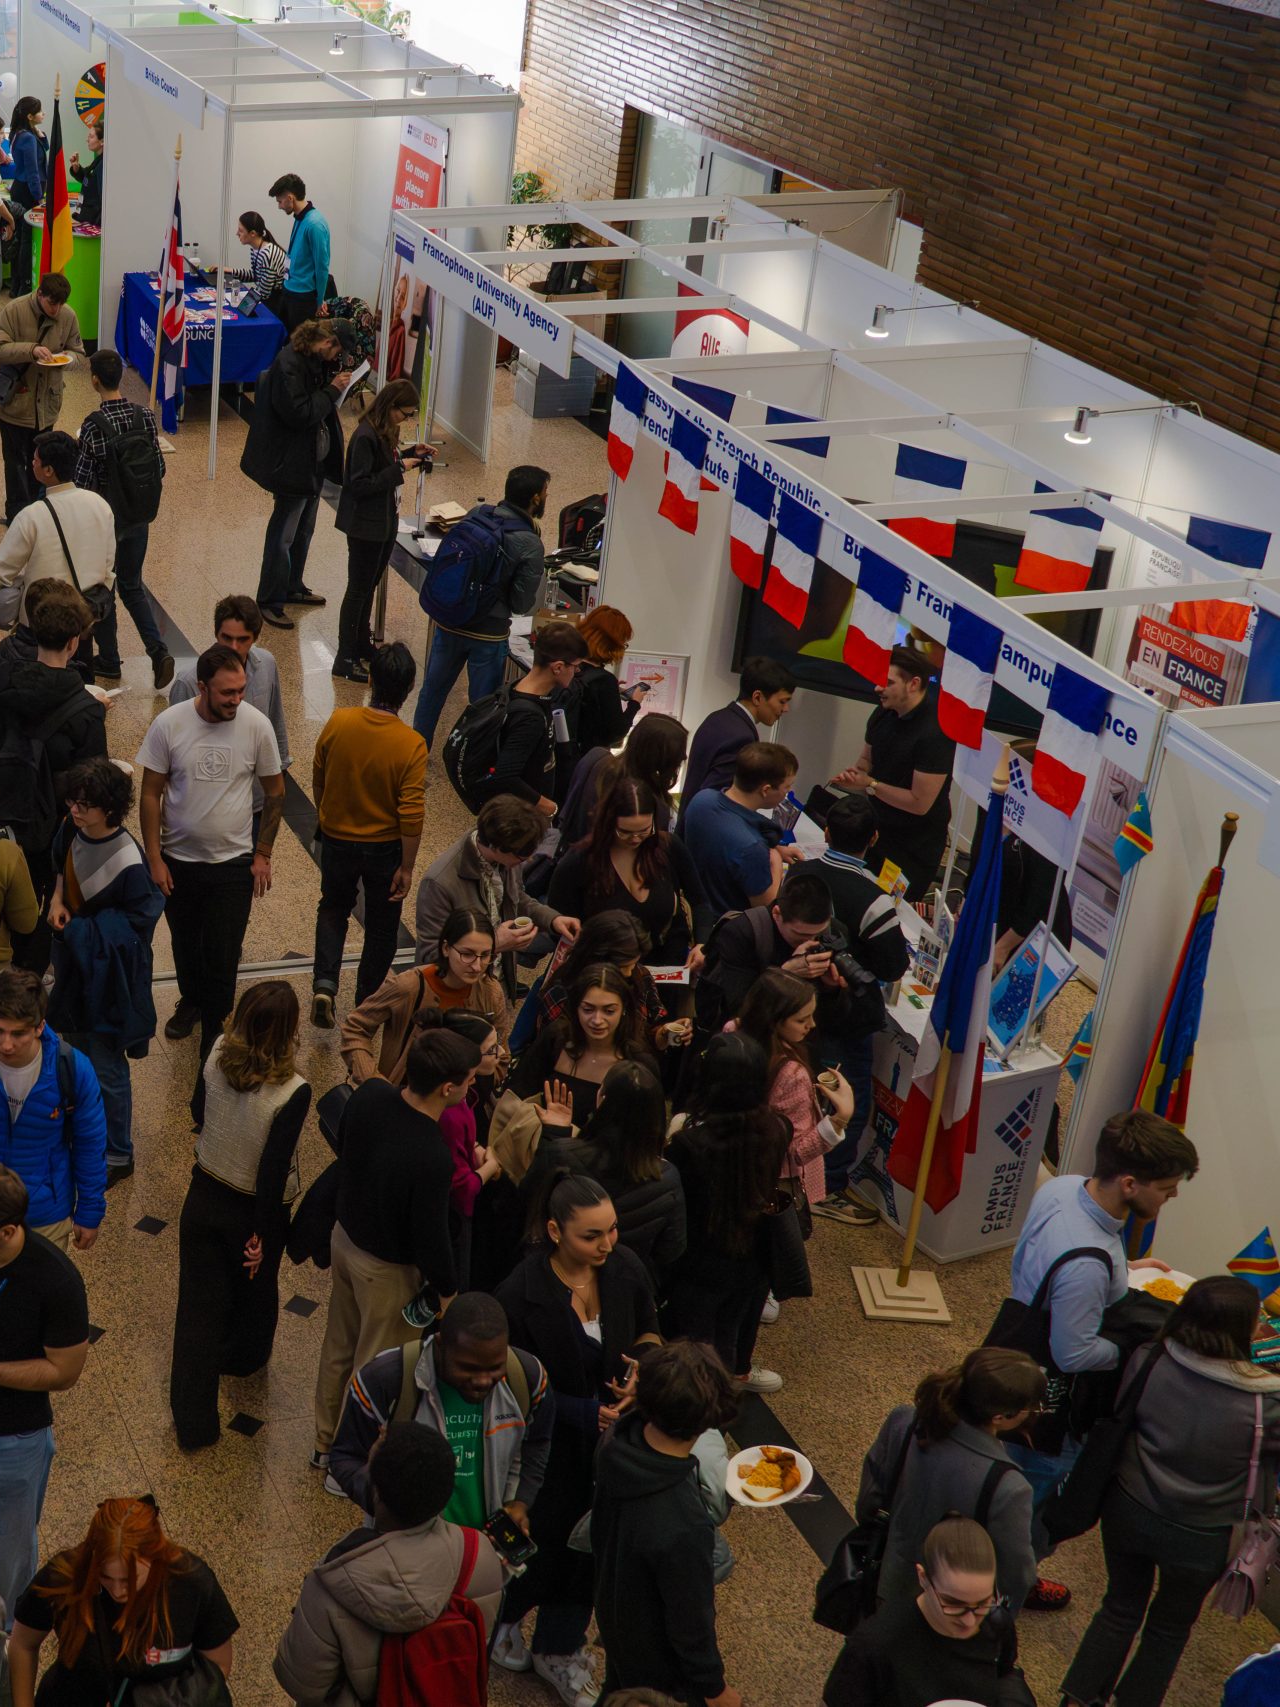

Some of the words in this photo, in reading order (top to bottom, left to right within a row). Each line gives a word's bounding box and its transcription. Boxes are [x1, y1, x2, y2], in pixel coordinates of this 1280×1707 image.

[145, 67, 160, 87] British
[160, 78, 179, 98] Council
[423, 132, 438, 149] IELTS
[404, 180, 425, 198] places
[405, 160, 413, 173] Go
[414, 167, 429, 182] more
[423, 237, 474, 283] Francophone
[476, 272, 521, 317] University
[523, 303, 559, 341] Agency
[472, 295, 496, 326] (AUF)
[185, 330, 216, 341] OUNC
[716, 430, 759, 470] French
[763, 461, 821, 513] Republic
[917, 582, 952, 621] Fran
[1143, 622, 1220, 672] RENDEZ-VOUS
[999, 643, 1052, 689] ampu
[1143, 646, 1161, 668] EN
[1167, 659, 1224, 700] FRANCE
[1103, 711, 1138, 746] nce
[1004, 793, 1025, 816] MPUS
[981, 1164, 1006, 1234] CAMPUS
[994, 1160, 1019, 1231] FRANCE
